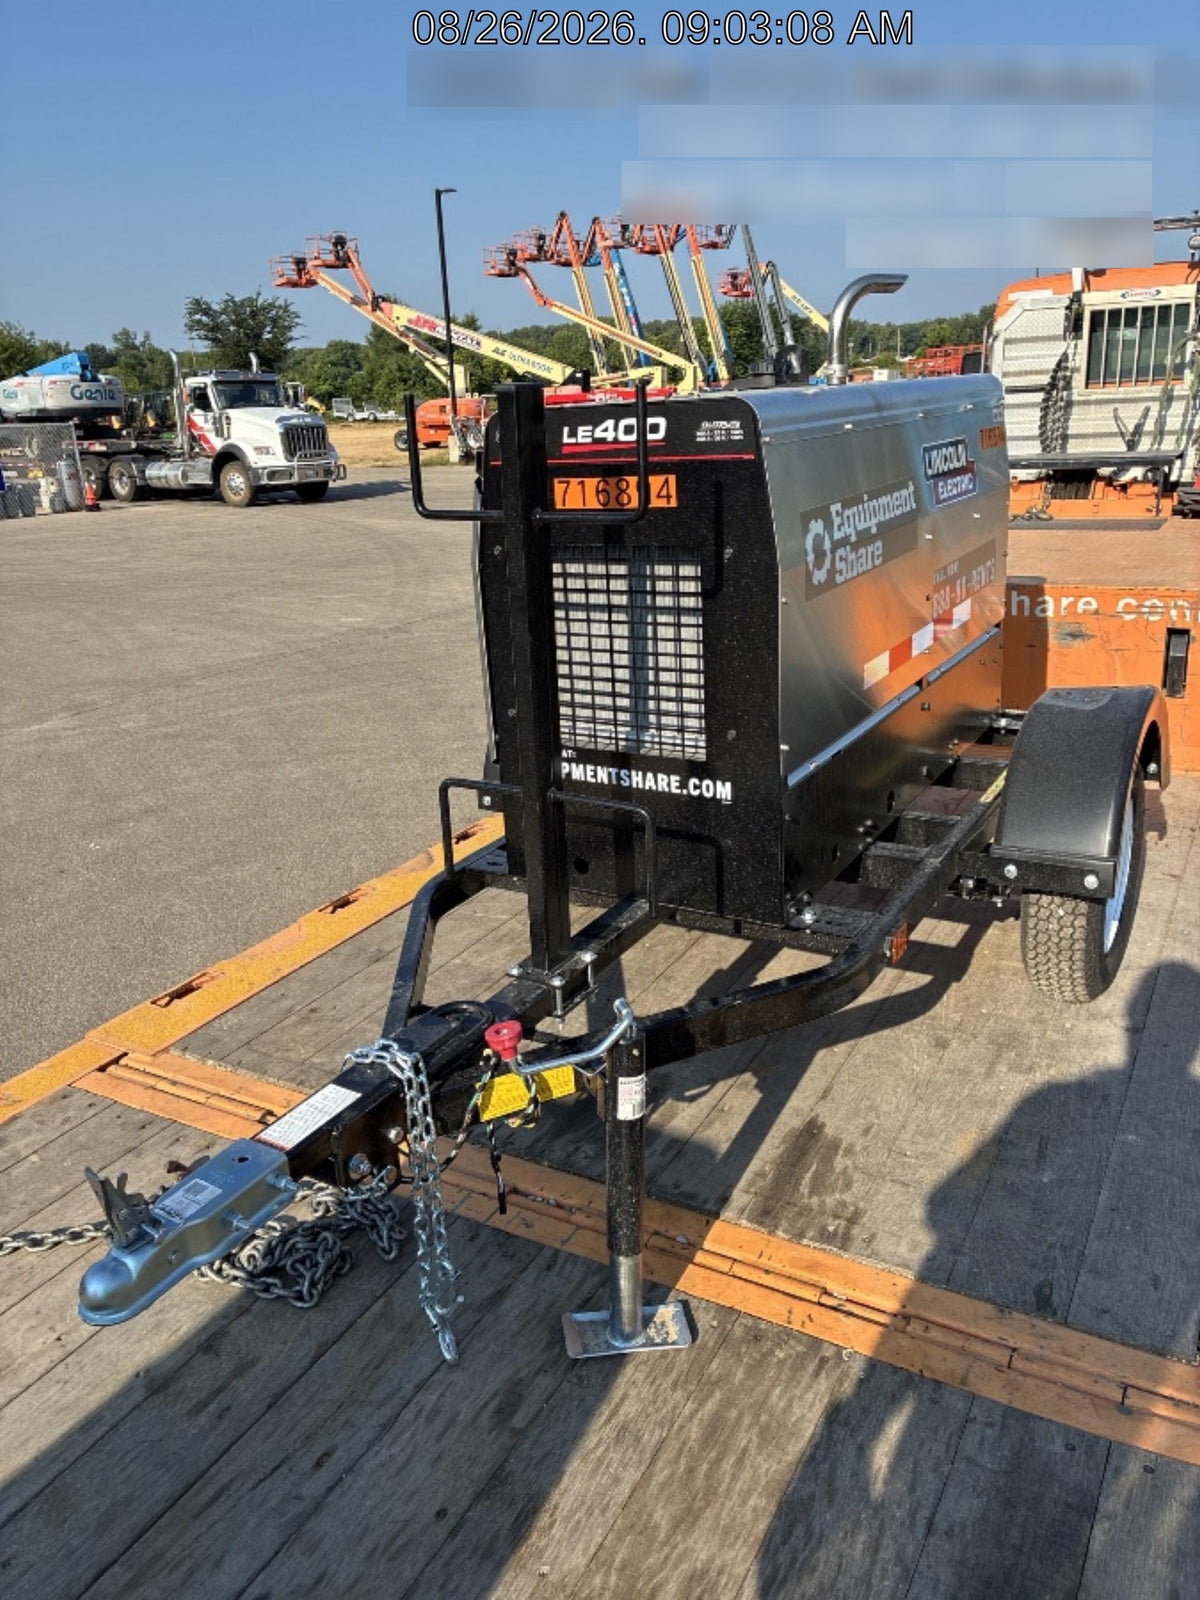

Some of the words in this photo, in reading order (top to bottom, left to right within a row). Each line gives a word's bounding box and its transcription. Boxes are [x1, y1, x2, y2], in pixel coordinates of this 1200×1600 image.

[70, 385, 116, 401] Genie
[562, 417, 668, 443] LE400
[925, 444, 966, 476] LINCOLN
[557, 478, 673, 506] 71684
[938, 472, 974, 500] ELECTRIC
[829, 481, 917, 542] Equipment
[834, 538, 883, 584] Share
